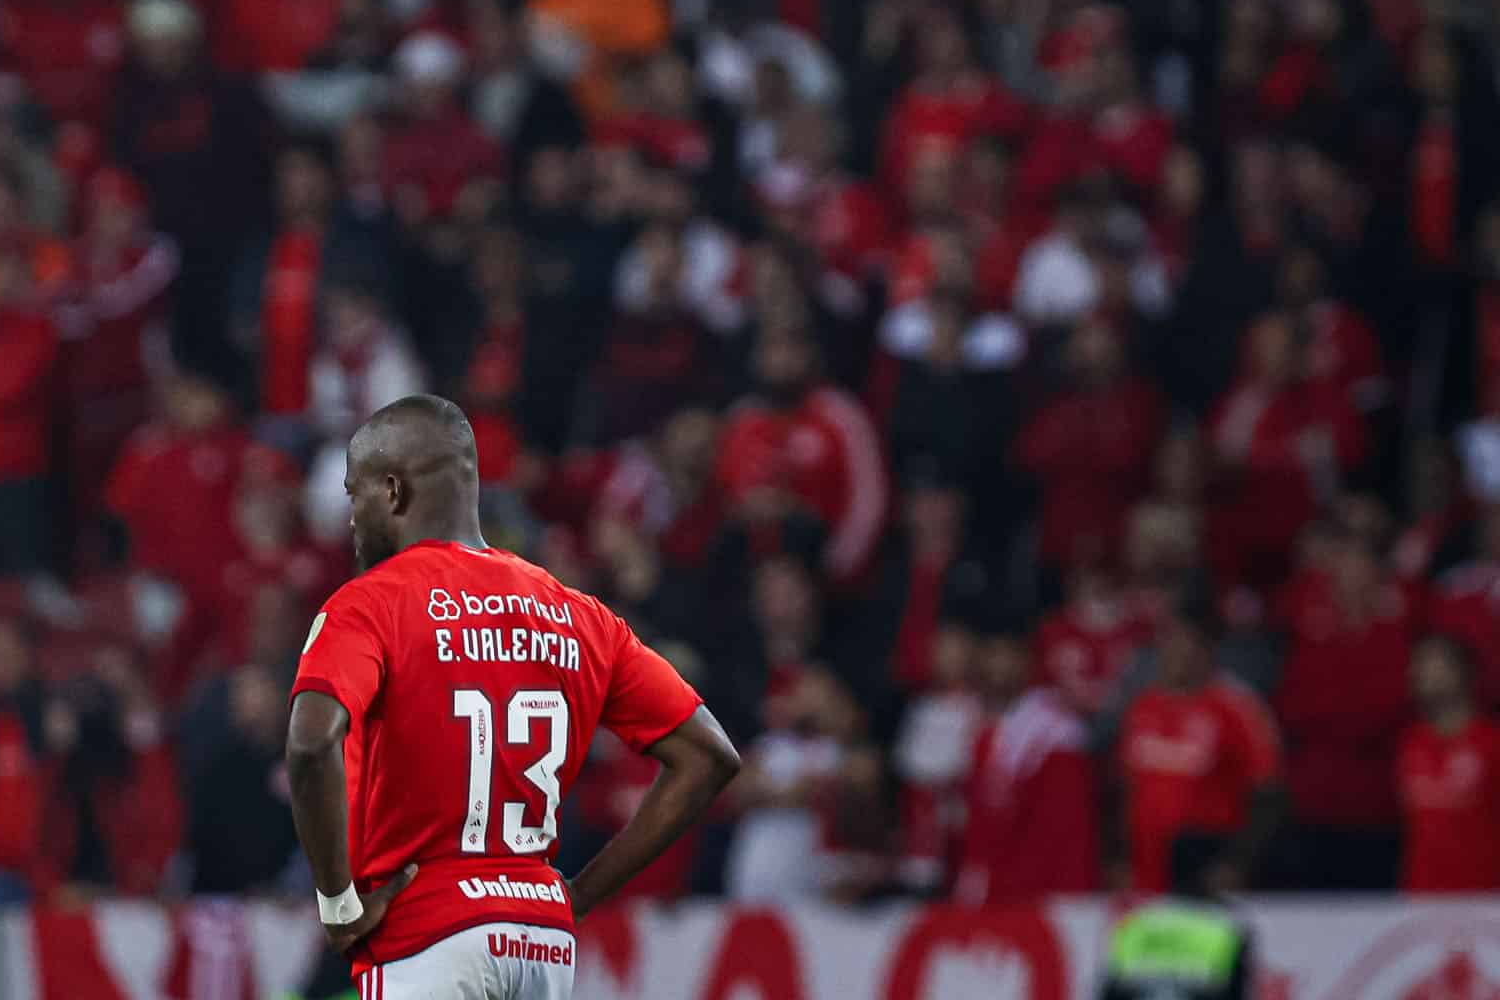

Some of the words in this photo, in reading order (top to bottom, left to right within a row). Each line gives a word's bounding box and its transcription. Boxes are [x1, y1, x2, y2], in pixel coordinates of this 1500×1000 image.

[454, 690, 569, 854] 13
[457, 874, 566, 904] Unimed
[487, 933, 573, 966] Unimed
